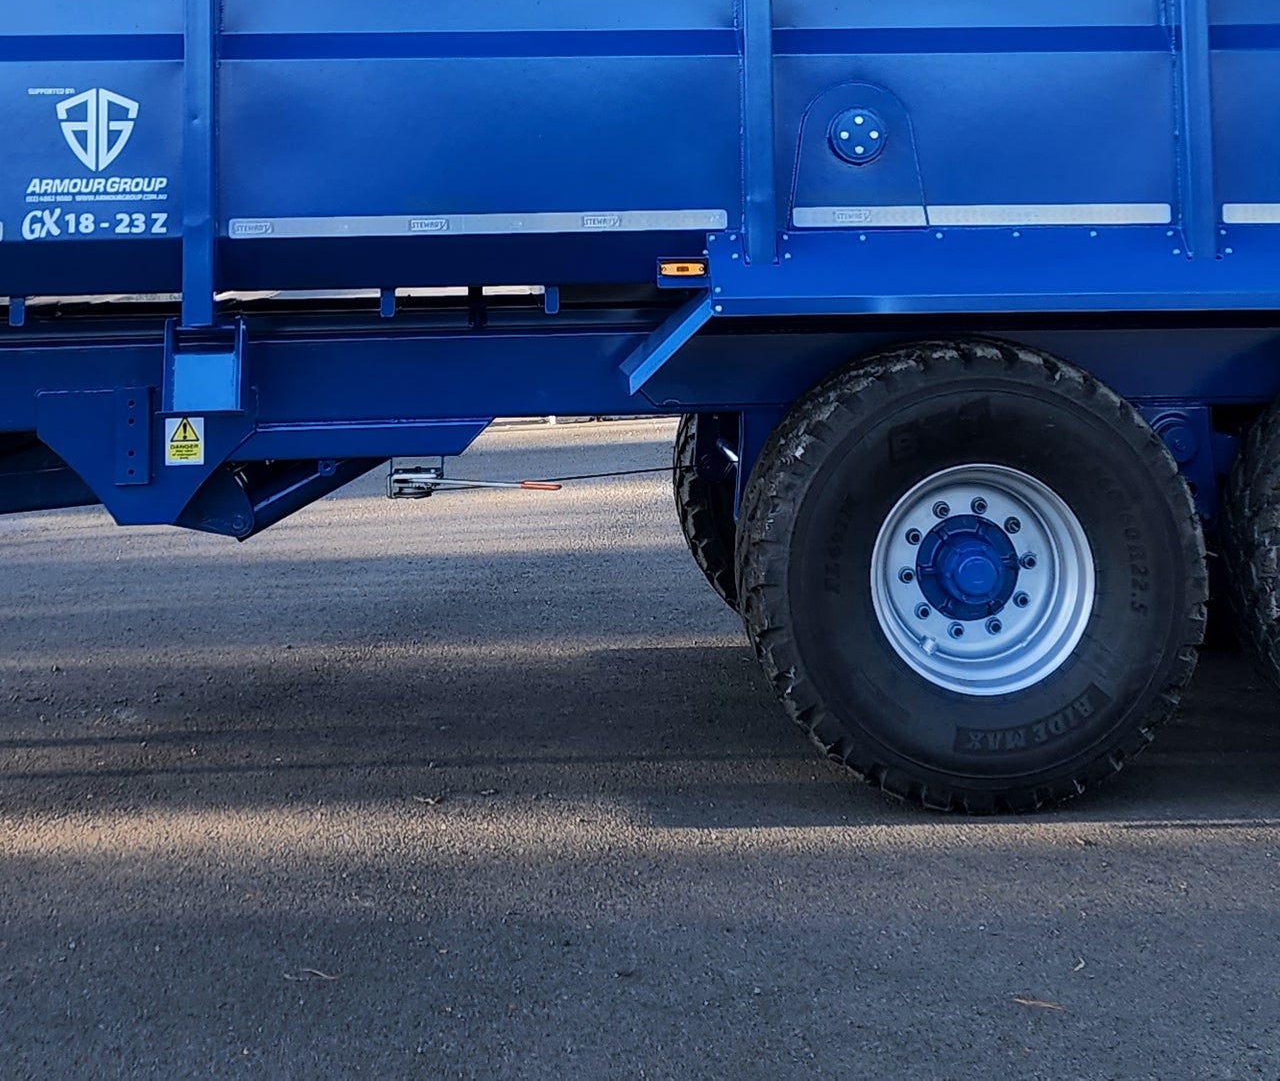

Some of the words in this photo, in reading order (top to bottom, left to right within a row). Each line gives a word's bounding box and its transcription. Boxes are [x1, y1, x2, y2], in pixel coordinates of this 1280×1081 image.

[22, 208, 61, 240] GX
[65, 213, 95, 234] 18
[115, 213, 146, 234] 23
[151, 213, 167, 234] Z
